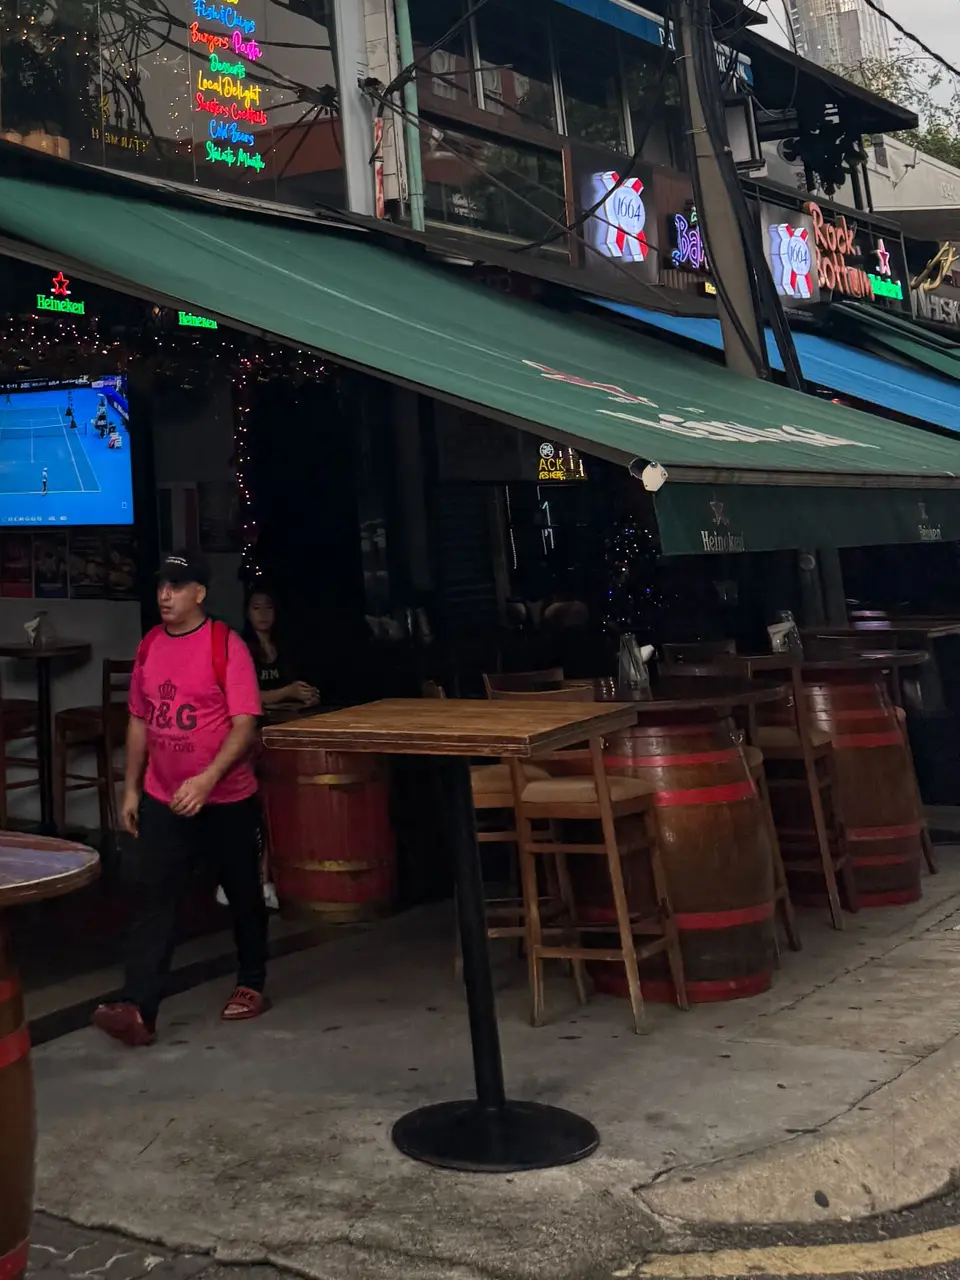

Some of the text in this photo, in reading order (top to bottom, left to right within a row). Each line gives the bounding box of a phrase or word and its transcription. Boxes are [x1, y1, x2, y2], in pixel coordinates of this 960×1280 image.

[189, 21, 263, 61] Burgers Pasta
[209, 53, 246, 79] Desserts
[197, 70, 262, 109] Local Delight
[209, 119, 255, 146] Cold Beers
[616, 196, 642, 223] 1664
[804, 201, 857, 256] Rock
[790, 242, 808, 266] 1664
[36, 294, 86, 315] Heineken
[539, 458, 566, 472] ACK
